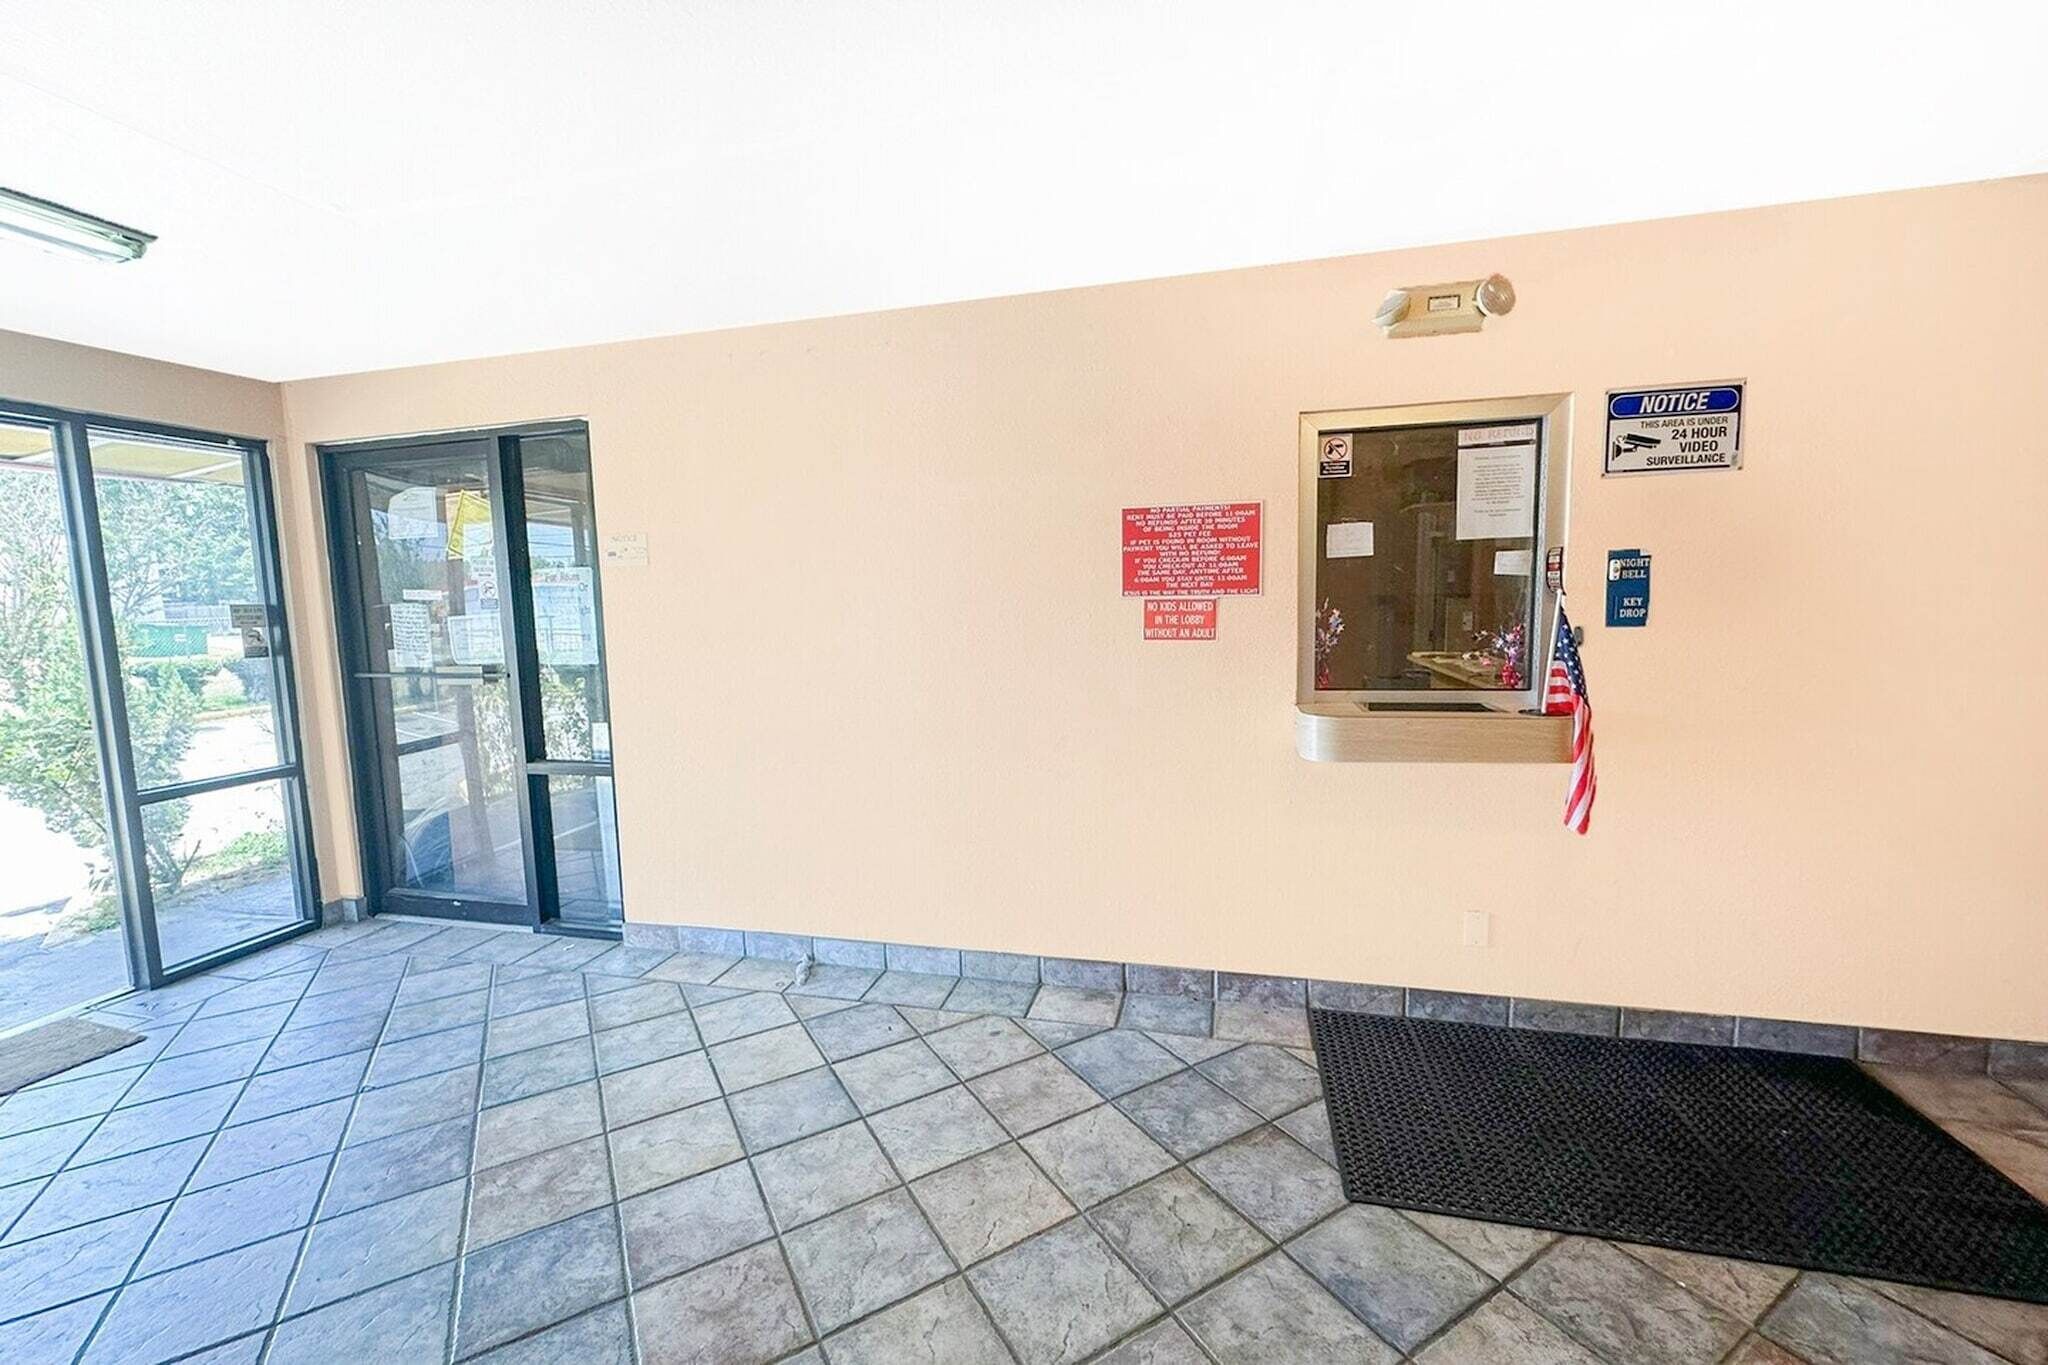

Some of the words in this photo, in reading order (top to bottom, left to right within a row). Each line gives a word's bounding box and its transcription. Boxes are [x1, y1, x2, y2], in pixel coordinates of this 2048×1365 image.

[1640, 392, 1711, 413] NOTICE
[1641, 420, 1659, 428] THIS
[1662, 419, 1684, 427] AREA
[1687, 418, 1695, 426] IS
[1698, 416, 1728, 425] UNDER
[1671, 428, 1687, 440] 24
[1692, 427, 1727, 438] HOUR
[1680, 441, 1718, 452] VIDEO
[1646, 453, 1725, 466] SURVEILLANCE
[1620, 558, 1649, 566] NIGHT
[1622, 570, 1646, 578] BELL
[1147, 602, 1158, 611] NO
[1160, 601, 1177, 611] KIDS
[1179, 601, 1213, 611] ALLOWED
[1624, 598, 1643, 606] KEY
[1620, 609, 1646, 617] DROP
[1155, 616, 1163, 624] IN
[1165, 616, 1179, 624] THE
[1182, 615, 1204, 624] LOBBY
[1146, 629, 1177, 638] WITHOUT
[1180, 629, 1191, 637] AN
[1193, 629, 1215, 637] ADULT
